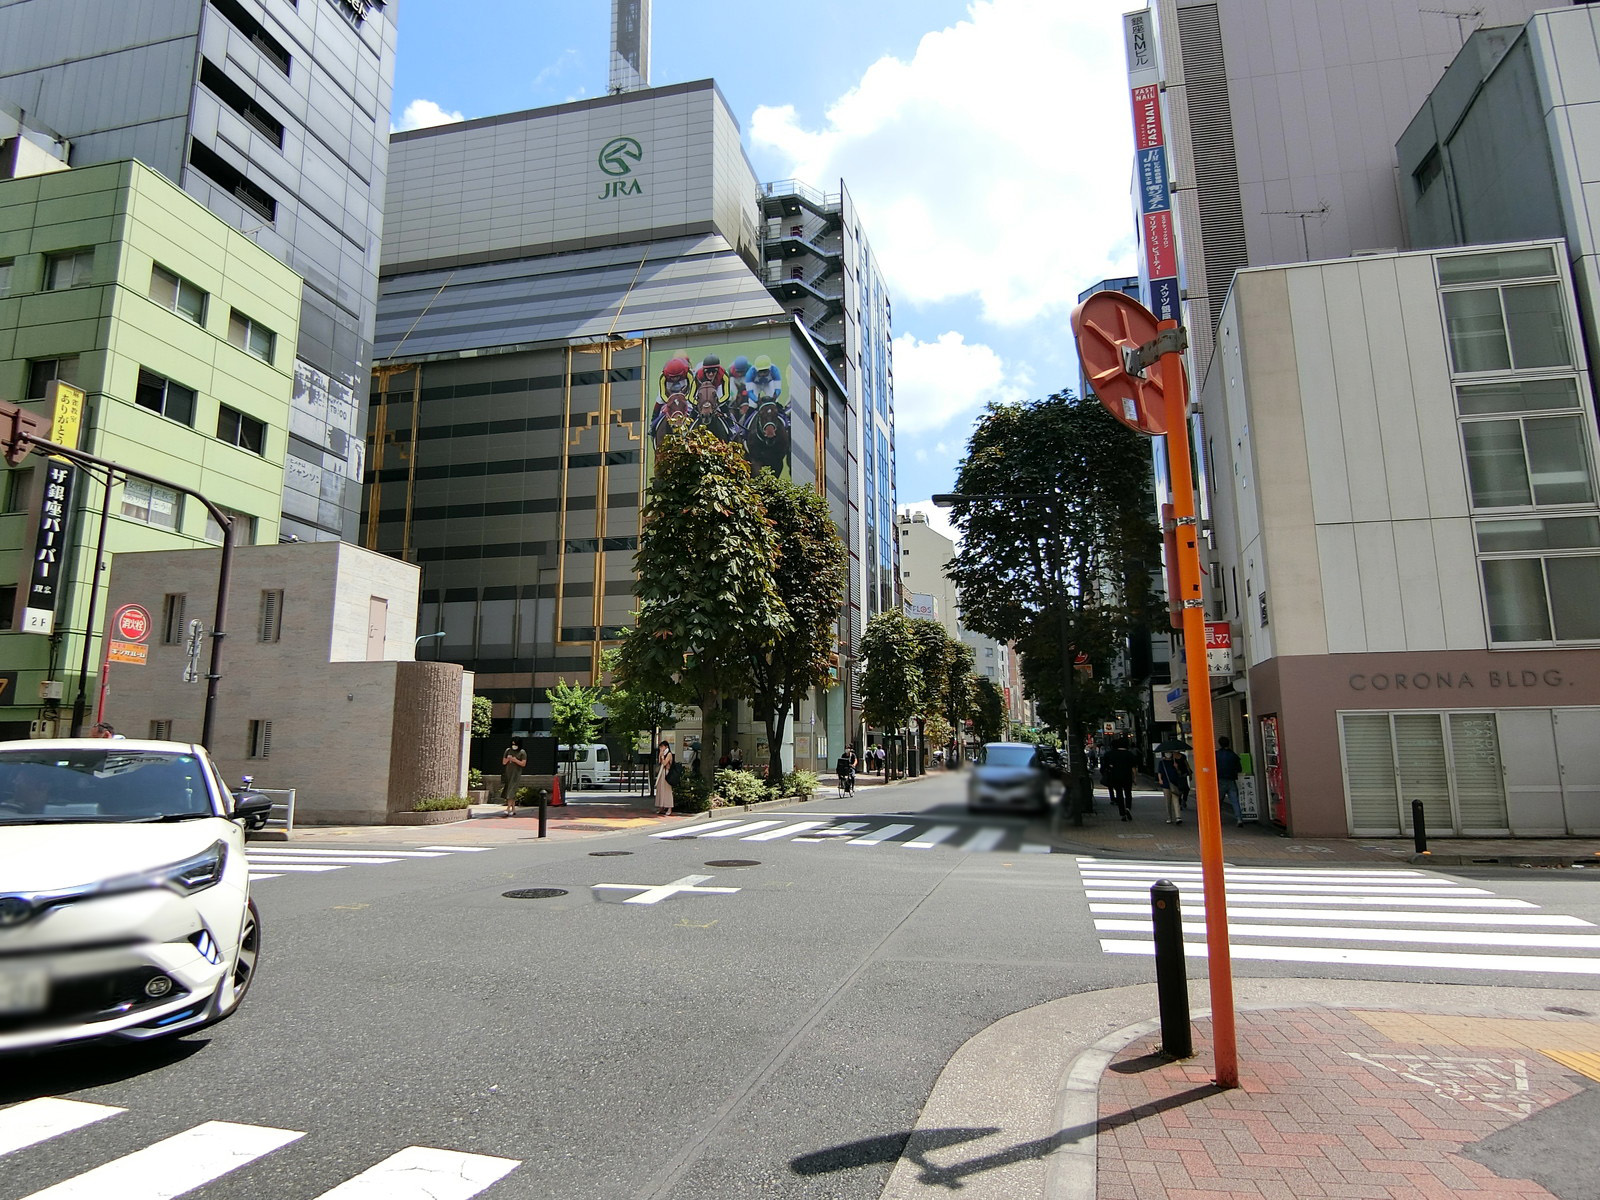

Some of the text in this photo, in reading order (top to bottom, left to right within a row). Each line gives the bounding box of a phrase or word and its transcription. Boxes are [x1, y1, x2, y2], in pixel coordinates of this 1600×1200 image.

[1130, 16, 1149, 66] 銀座NMビル
[1134, 86, 1154, 95] FAST
[1135, 92, 1155, 102] NAIL
[1144, 100, 1158, 147] FASTNAIL
[597, 178, 643, 200] JRA
[37, 468, 69, 578] ザ銀座バーバー
[912, 605, 932, 614] FLOS
[122, 617, 145, 632] 消火栓
[1349, 668, 1575, 691] CORONA BLDG.
[1483, 720, 1497, 765] RADIO
